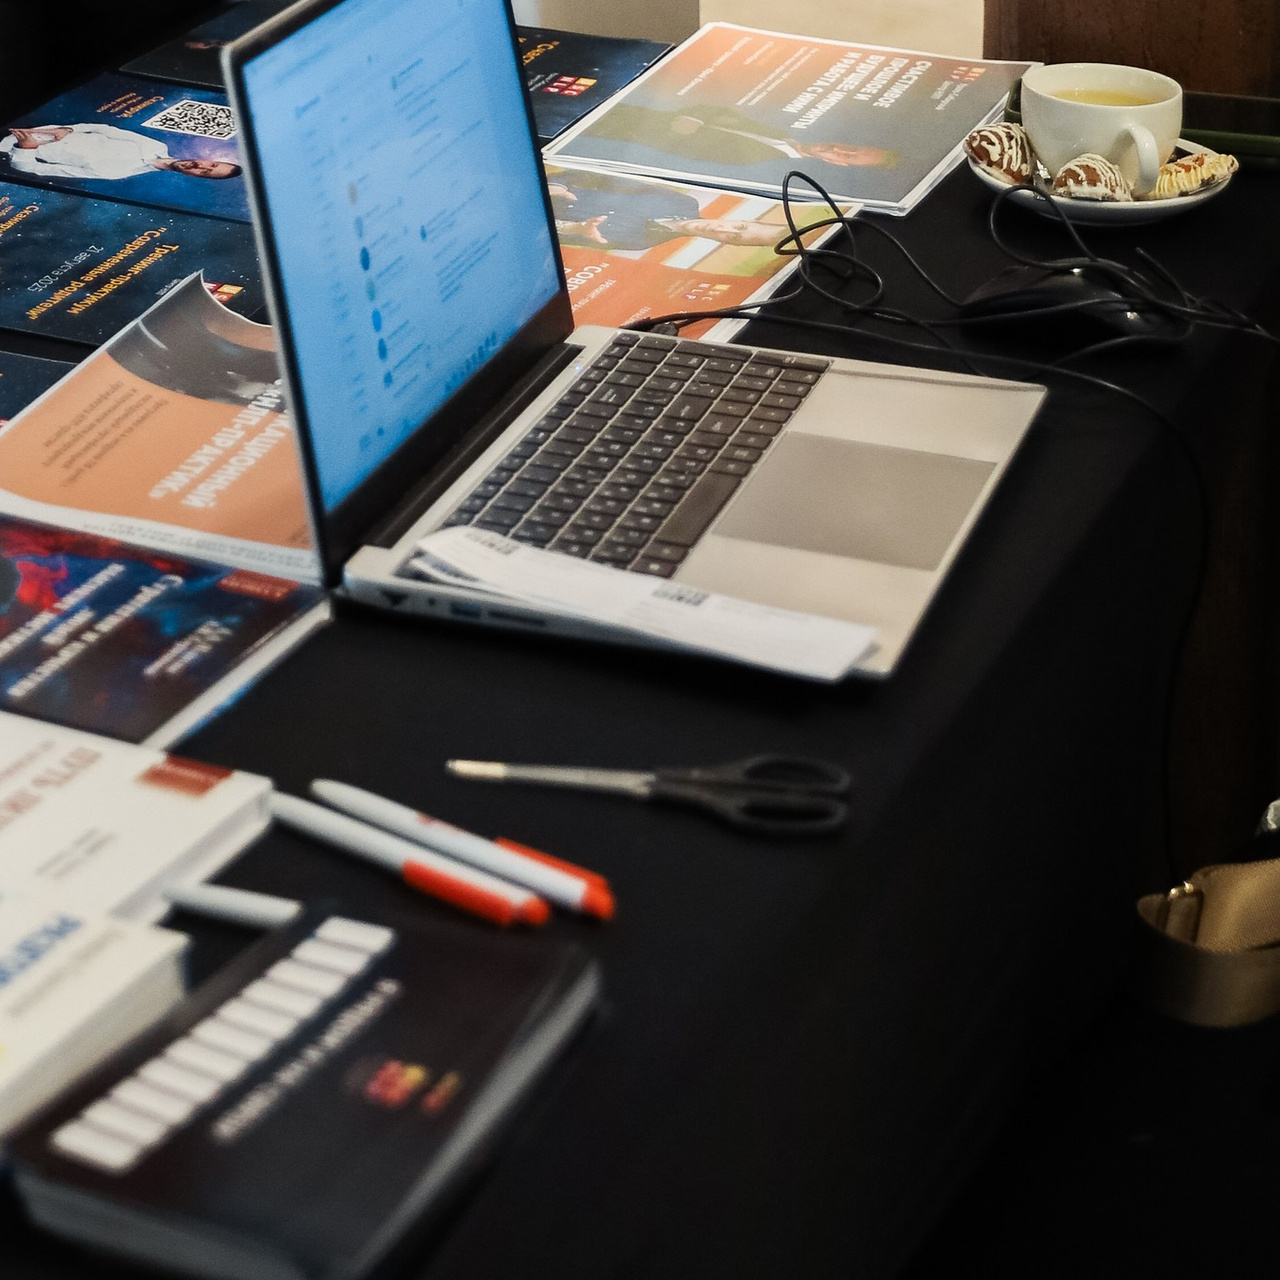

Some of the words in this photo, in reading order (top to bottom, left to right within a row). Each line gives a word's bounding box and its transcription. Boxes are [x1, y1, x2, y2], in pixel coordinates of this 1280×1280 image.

[814, 58, 857, 87] РАБОТА
[859, 57, 910, 93] ПРОШЛОЕ
[873, 60, 934, 108] СЧАСТЛИВОЕ
[782, 92, 818, 113] НИМИ
[50, 251, 92, 276] августа
[88, 244, 104, 254] 21
[26, 273, 57, 292] 2025
[66, 243, 179, 315] Тренинг-практикум
[178, 412, 289, 510] КАЦИОННЫЙ
